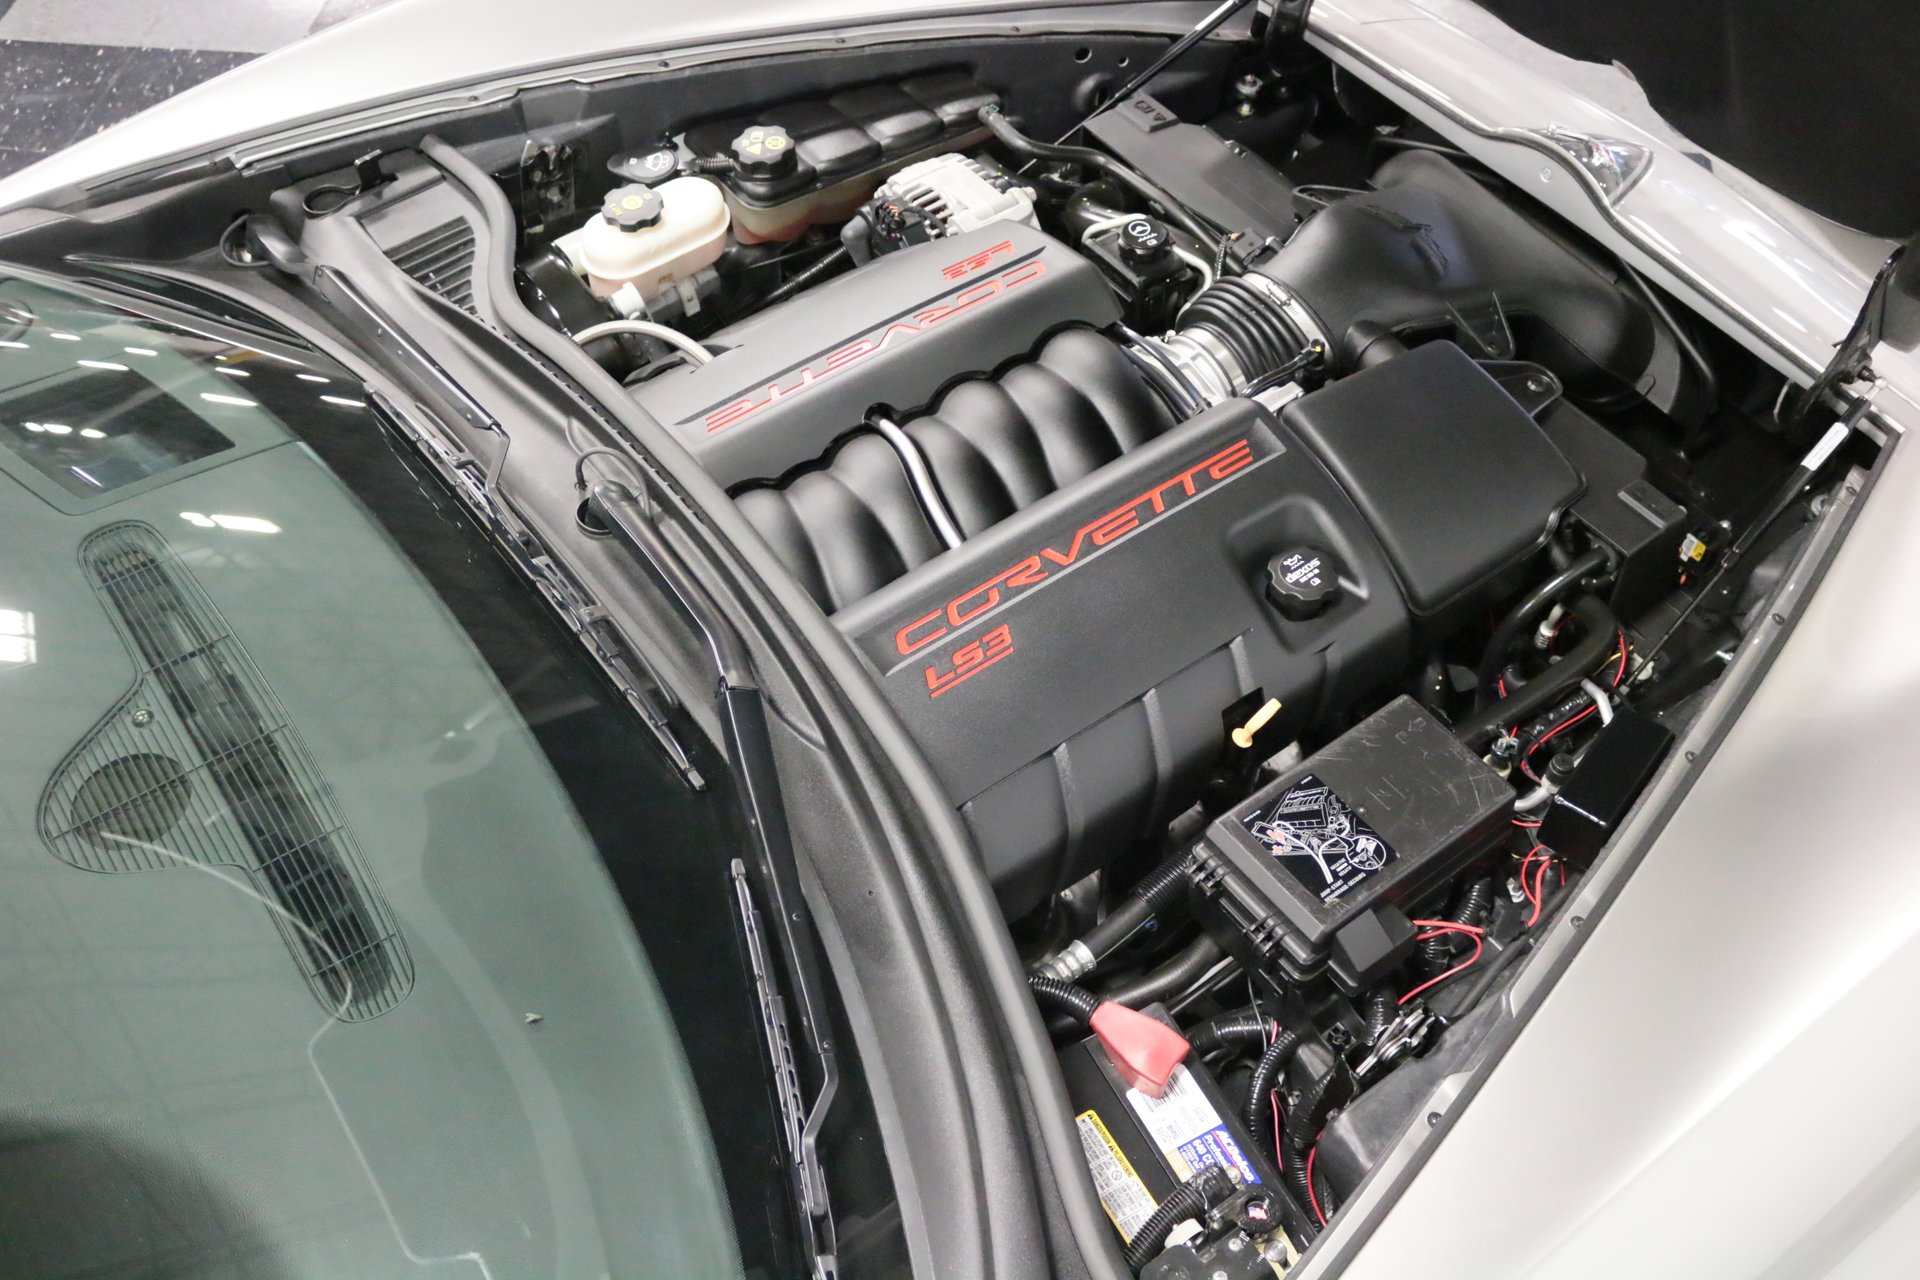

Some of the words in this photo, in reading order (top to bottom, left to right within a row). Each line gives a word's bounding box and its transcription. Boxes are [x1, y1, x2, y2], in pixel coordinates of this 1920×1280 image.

[941, 240, 1015, 280] LS3
[704, 260, 1046, 434] CORVETTE
[895, 439, 1254, 656] CORVETTE
[1285, 557, 1321, 583] dexos
[924, 624, 1014, 690] LS3
[1192, 1139, 1208, 1155] 640
[1215, 1130, 1255, 1182] ACDelco
